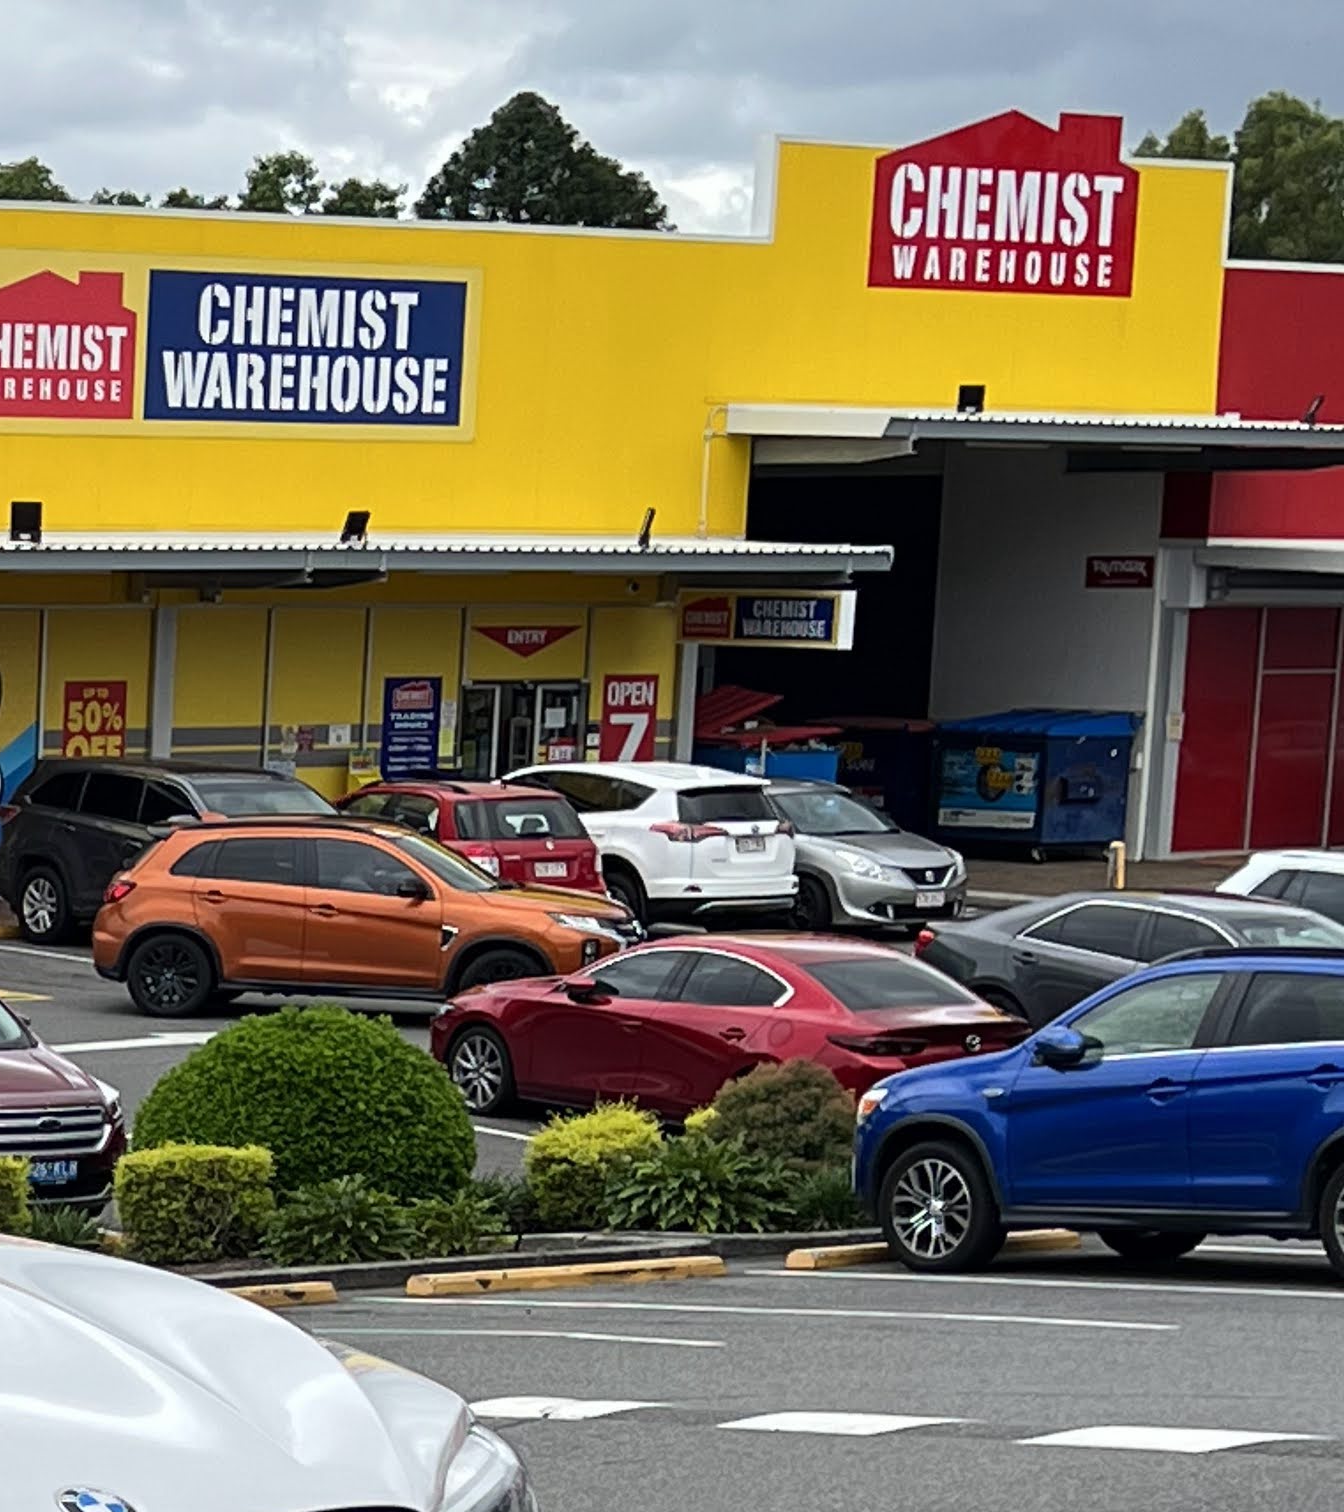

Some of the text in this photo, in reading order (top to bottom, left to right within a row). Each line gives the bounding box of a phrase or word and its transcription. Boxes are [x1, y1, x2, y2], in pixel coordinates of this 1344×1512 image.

[890, 163, 1124, 247] CHEMIST
[893, 245, 1112, 289] WAREHOUSE
[198, 283, 418, 351] CHEMIST
[162, 351, 448, 414] WAREHOUSE
[742, 618, 827, 638] WAREHOUSE
[753, 600, 817, 619] CHEMIST
[507, 629, 547, 644] ENTRY
[608, 681, 655, 706] OPEN
[67, 700, 123, 733] 50%
[610, 713, 650, 762] 7
